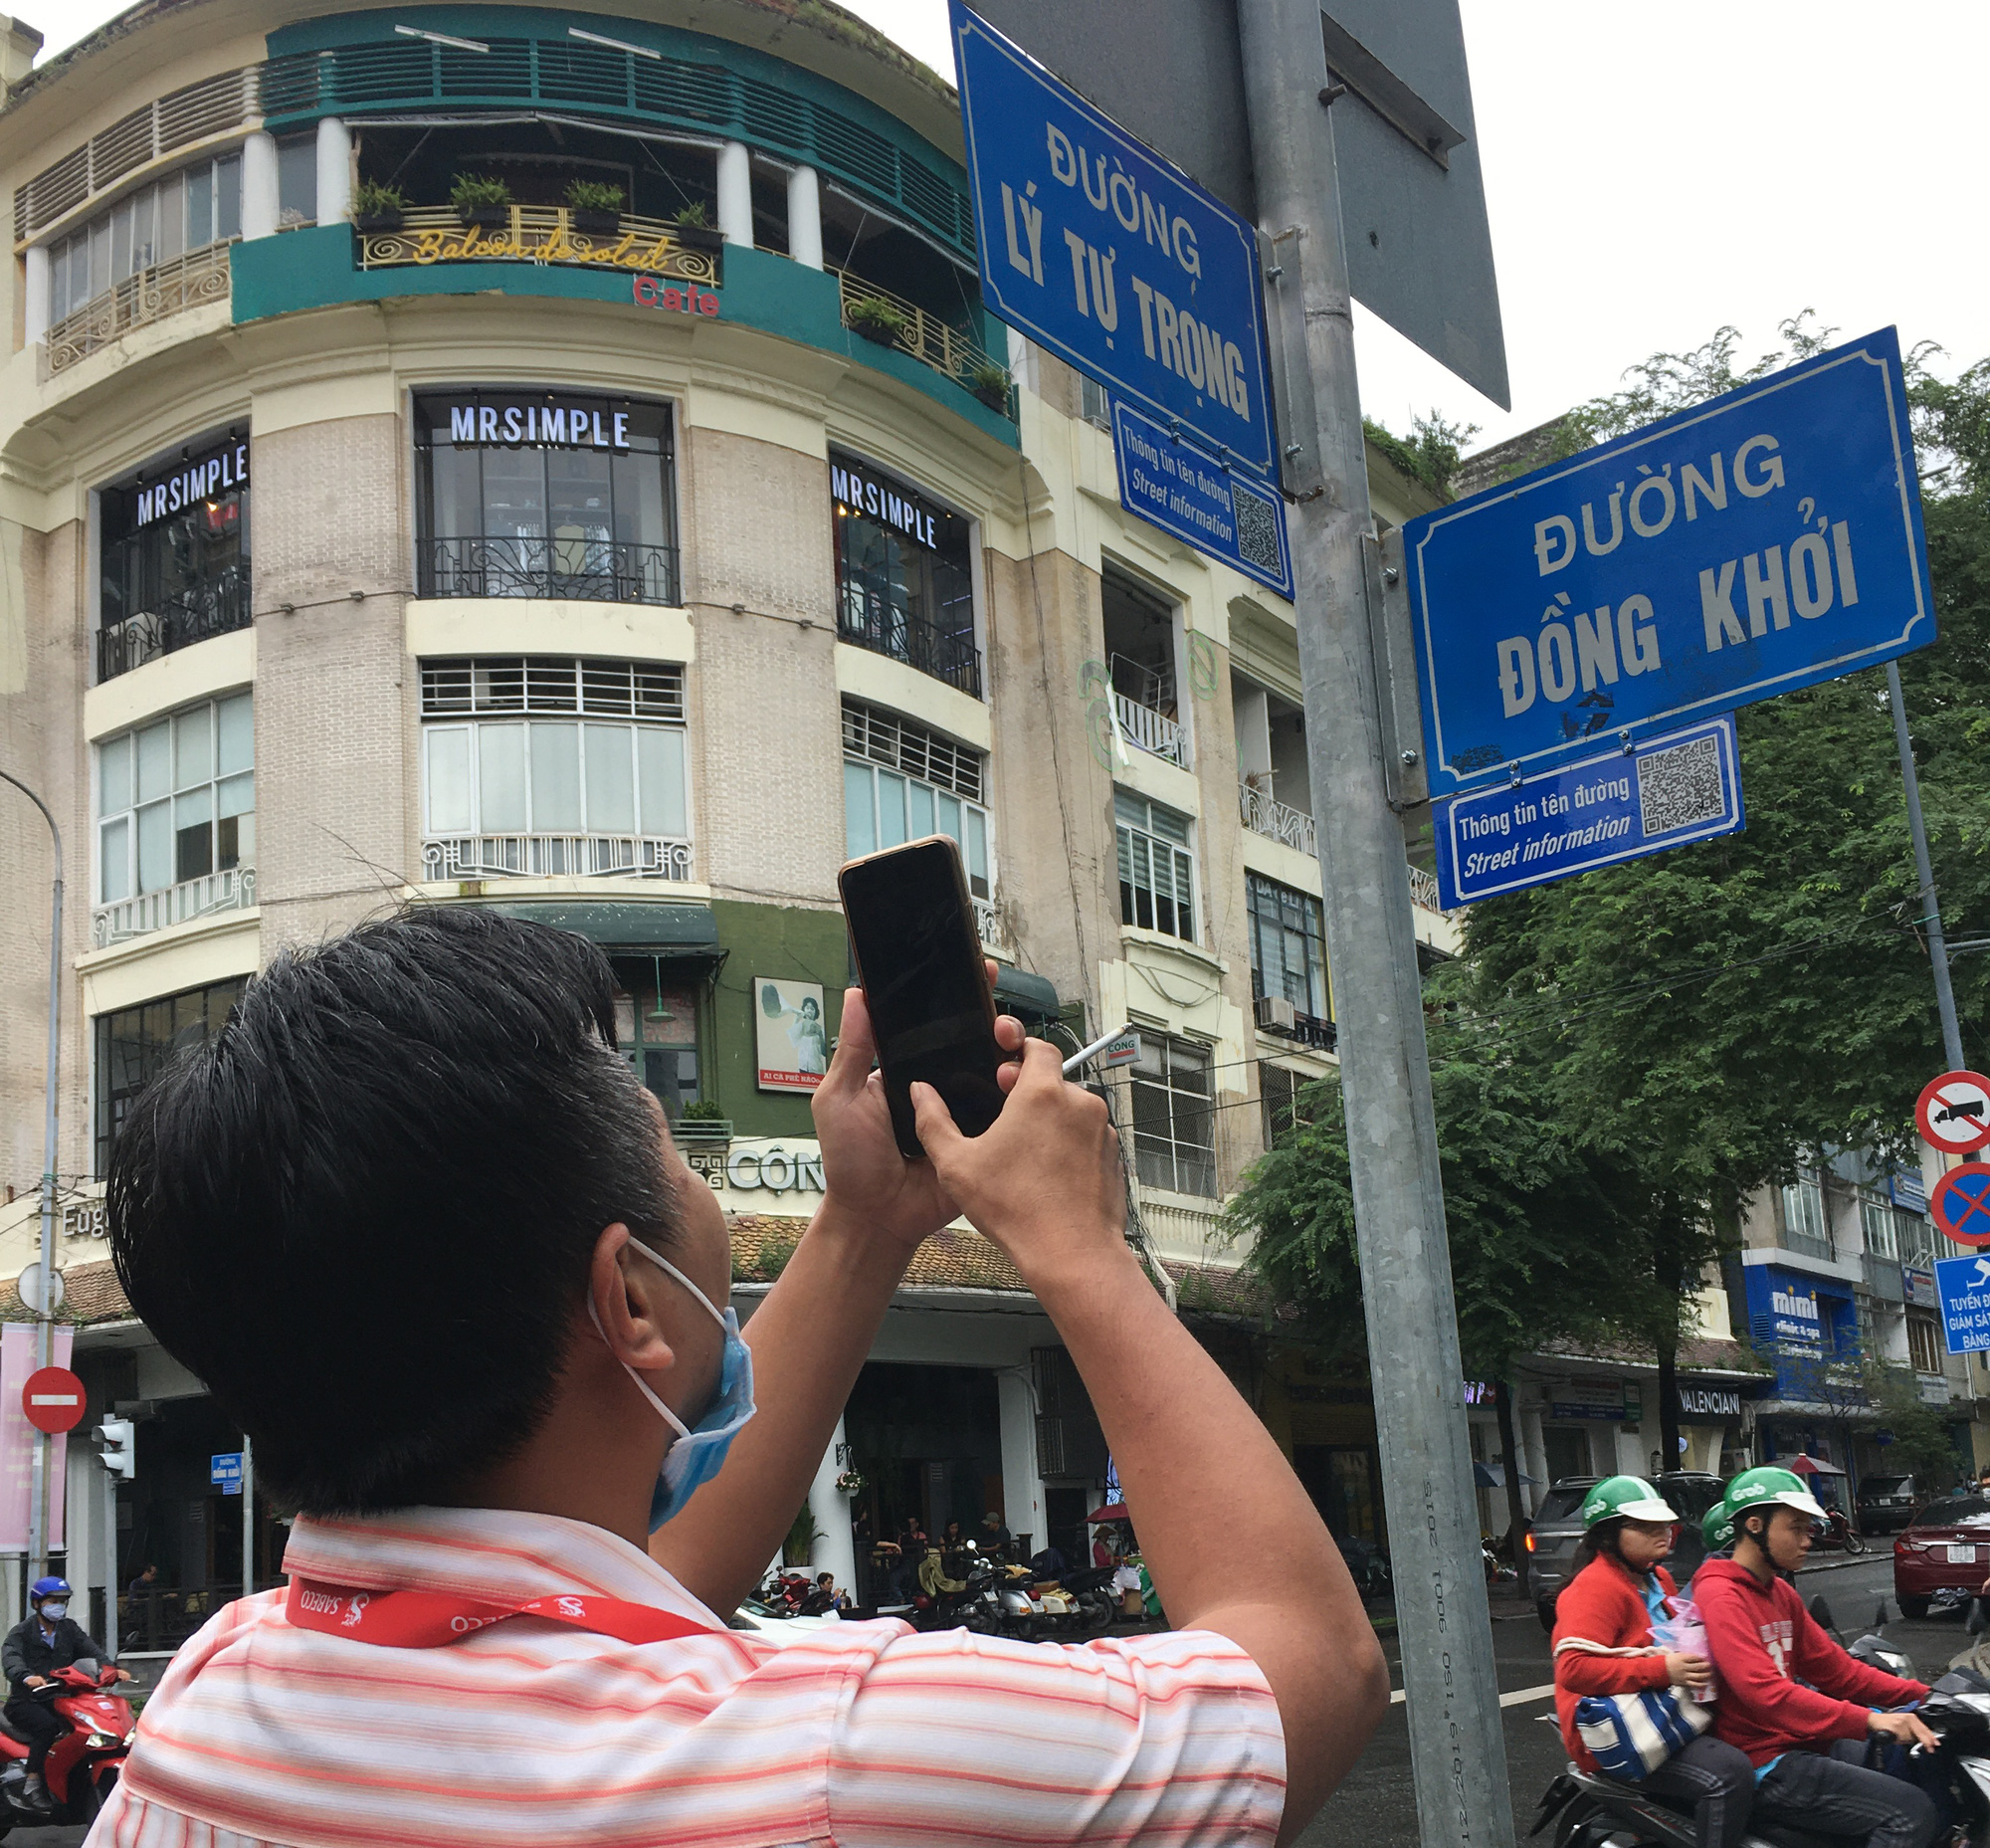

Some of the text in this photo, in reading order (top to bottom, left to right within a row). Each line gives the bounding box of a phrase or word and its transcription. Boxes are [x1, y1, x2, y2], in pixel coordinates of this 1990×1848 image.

[1046, 120, 1202, 280] ĐƯỜNG
[632, 276, 720, 316] Cafe
[1000, 179, 1251, 423] LÝ TỰ TRỌNG
[451, 406, 631, 448] MRSIMPLE
[137, 444, 248, 527] MRSIMPLE
[1122, 424, 1232, 513] Thông tin tên đường
[831, 464, 937, 550] MRSIMPLE
[1132, 468, 1233, 543] Street information
[1533, 434, 1786, 577] ĐƯỜNG
[1495, 497, 1860, 719] ĐỒNG KHỞI
[1459, 776, 1630, 842] Thông tin tên đường
[1464, 815, 1631, 879] Street information
[62, 1204, 109, 1238] Eug
[1772, 1285, 1819, 1321] mimi
[1948, 1291, 1982, 1313] TUYẾN
[1948, 1313, 1974, 1331] GIÁM
[1679, 1388, 1741, 1415] VALENCIANI
[300, 1589, 342, 1615] SABECO
